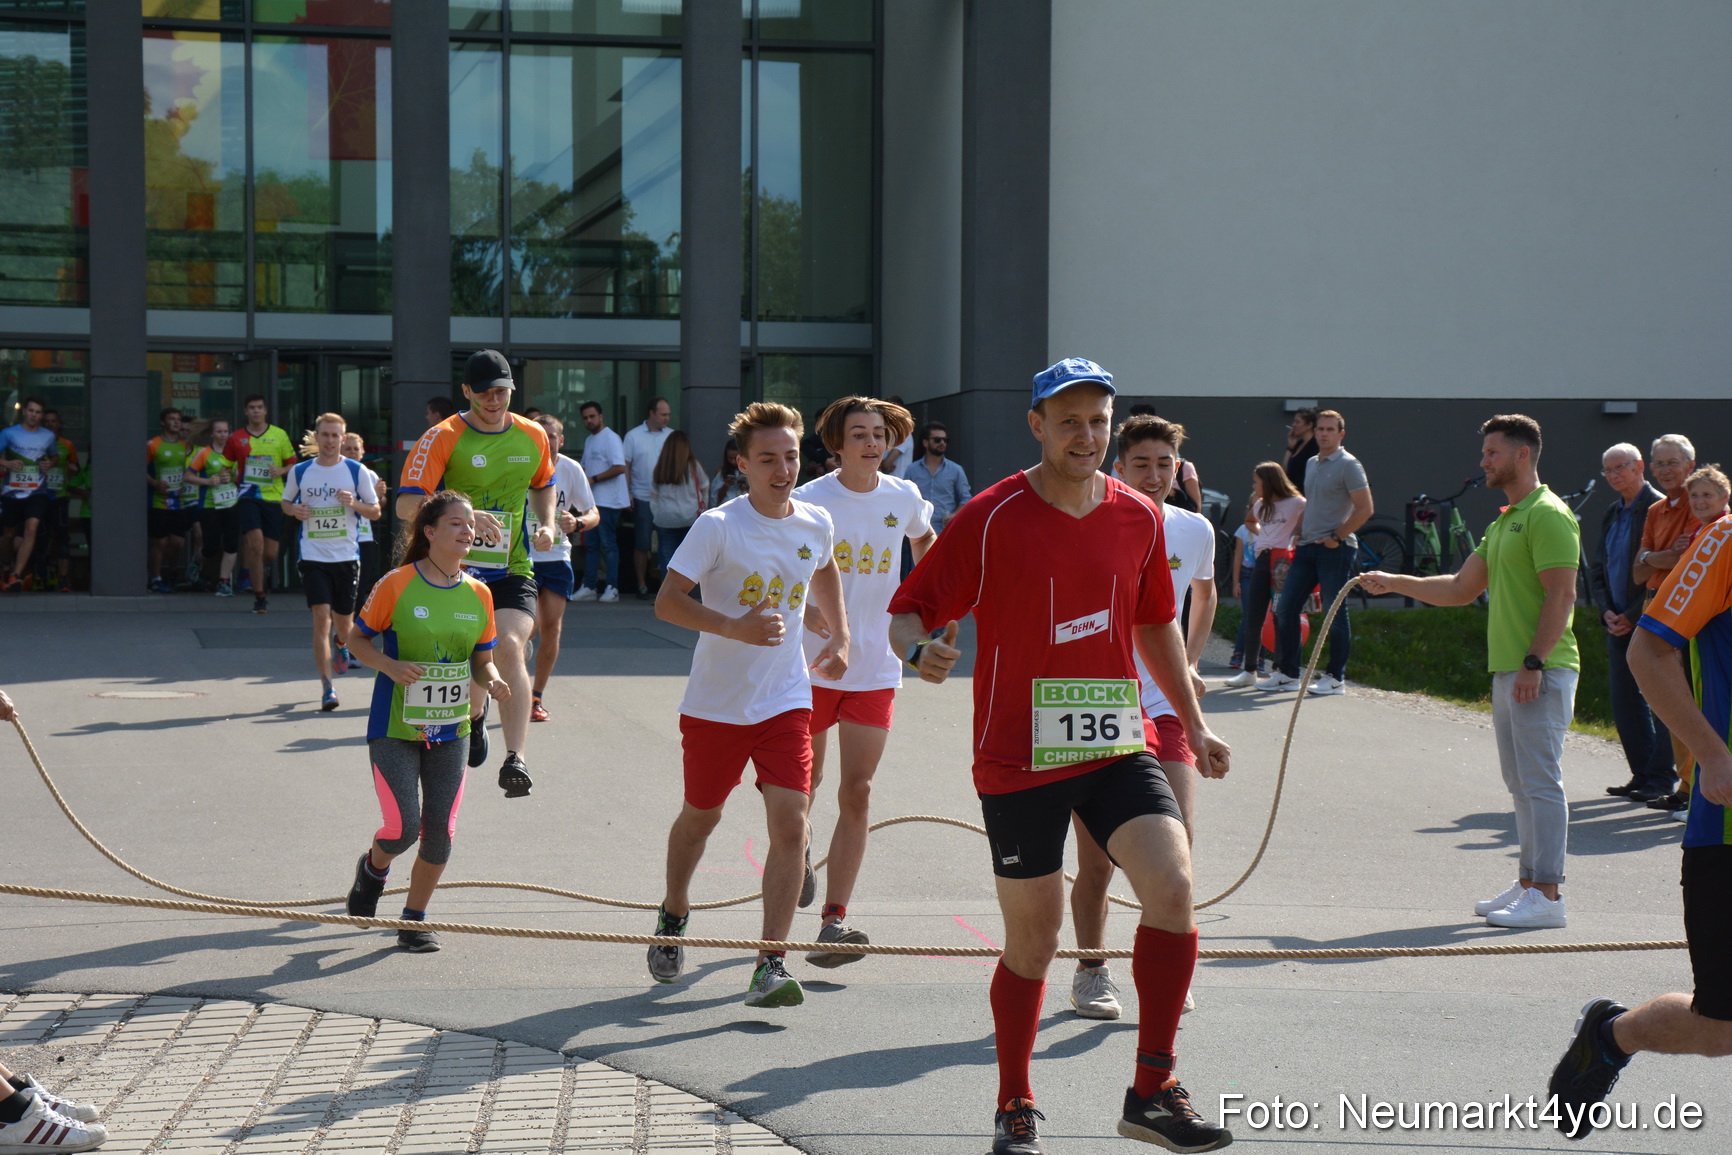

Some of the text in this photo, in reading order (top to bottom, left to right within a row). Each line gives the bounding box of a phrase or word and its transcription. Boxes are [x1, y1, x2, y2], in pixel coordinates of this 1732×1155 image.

[15, 474, 33, 482] 524
[252, 467, 269, 477] 178
[219, 490, 236, 500] 121
[306, 484, 338, 500] SUSP
[314, 518, 339, 529] 142
[1664, 516, 1732, 615] BOCK
[1071, 620, 1096, 635] DEHN
[422, 685, 461, 703] 119
[1041, 683, 1131, 704] BOCK
[426, 709, 455, 718] KYRA
[1058, 713, 1120, 741] 136
